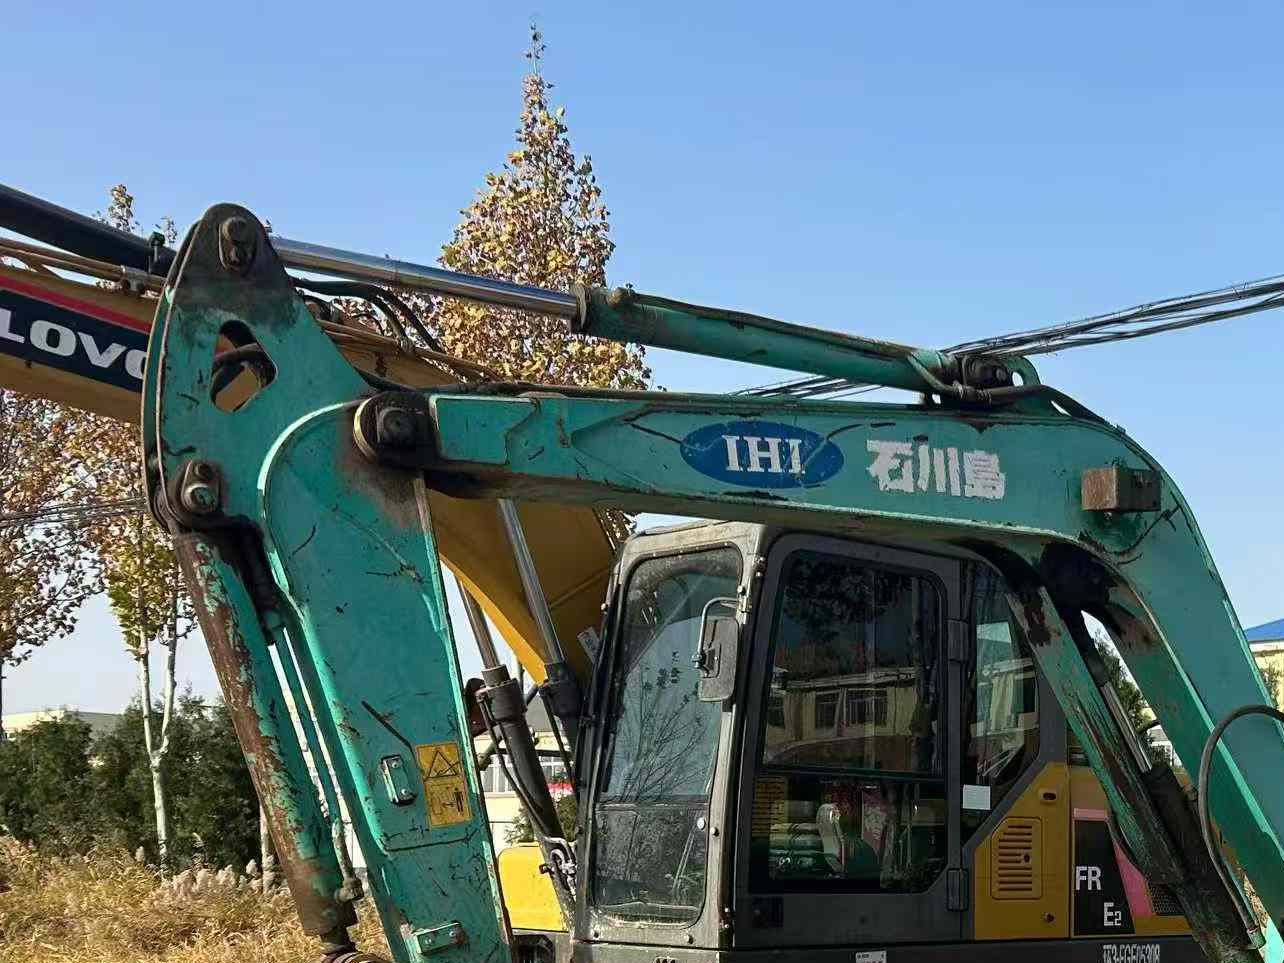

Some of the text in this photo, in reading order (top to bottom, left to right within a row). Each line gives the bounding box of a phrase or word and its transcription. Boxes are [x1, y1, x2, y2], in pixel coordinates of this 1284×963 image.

[721, 434, 805, 474] IHI
[1075, 865, 1102, 891] FR
[1103, 902, 1122, 926] E2
